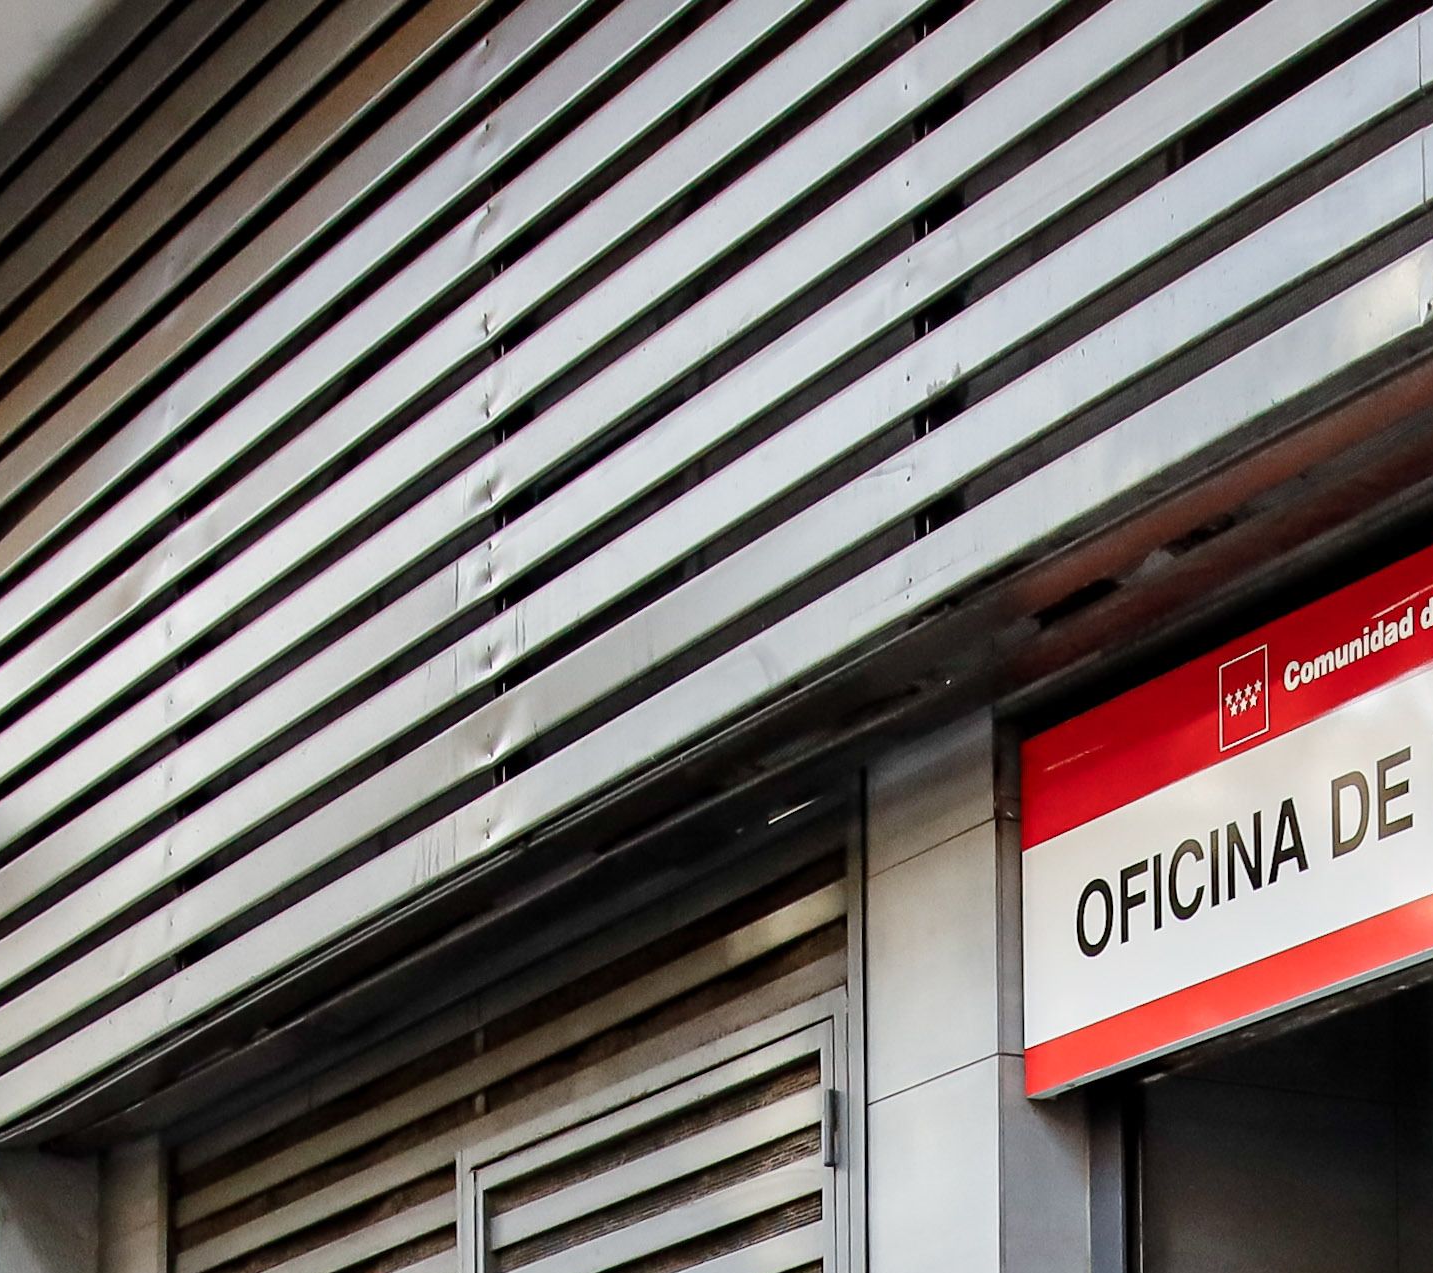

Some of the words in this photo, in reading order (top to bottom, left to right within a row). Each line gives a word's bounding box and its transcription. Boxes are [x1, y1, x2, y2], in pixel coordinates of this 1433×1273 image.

[1283, 615, 1415, 693] Comunidad
[1076, 797, 1309, 959] OFICINA
[1331, 745, 1415, 860] DE
